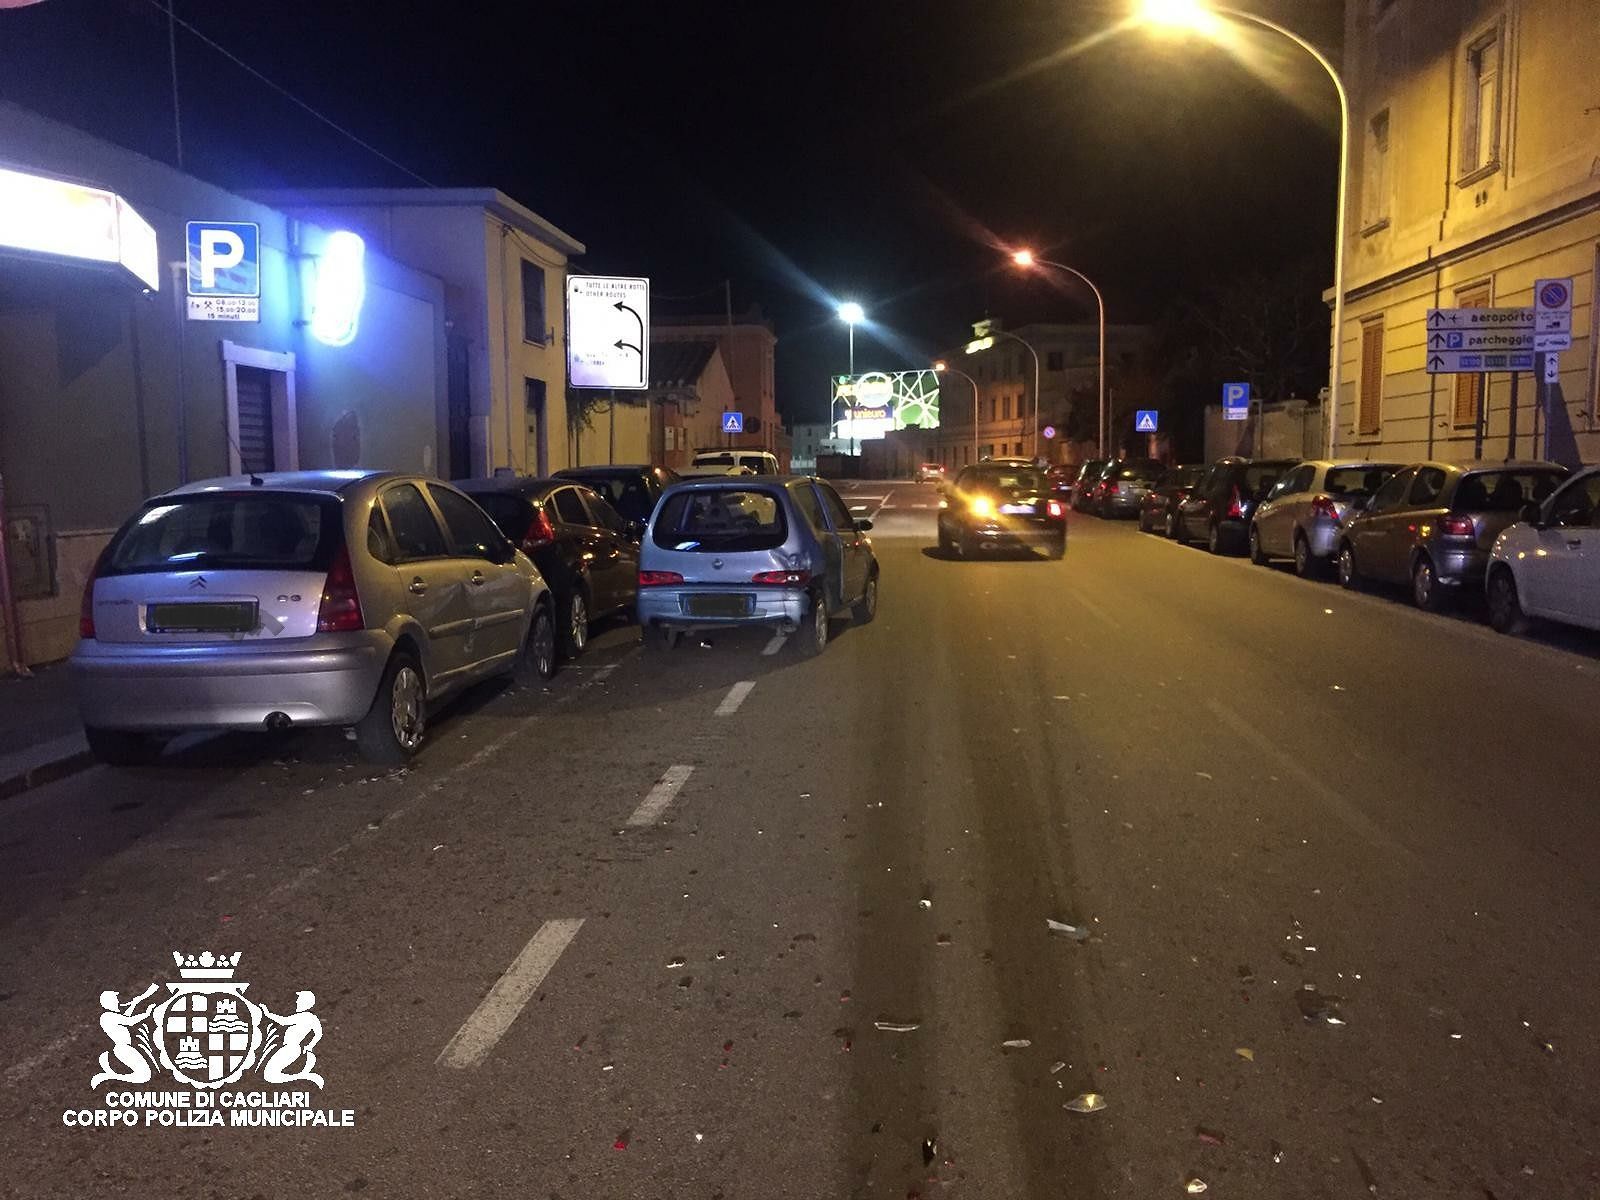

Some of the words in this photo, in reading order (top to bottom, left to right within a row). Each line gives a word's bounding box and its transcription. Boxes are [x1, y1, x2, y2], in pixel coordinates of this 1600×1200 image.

[200, 229, 245, 288] P
[1471, 310, 1533, 323] aeroporto
[1228, 385, 1244, 406] P
